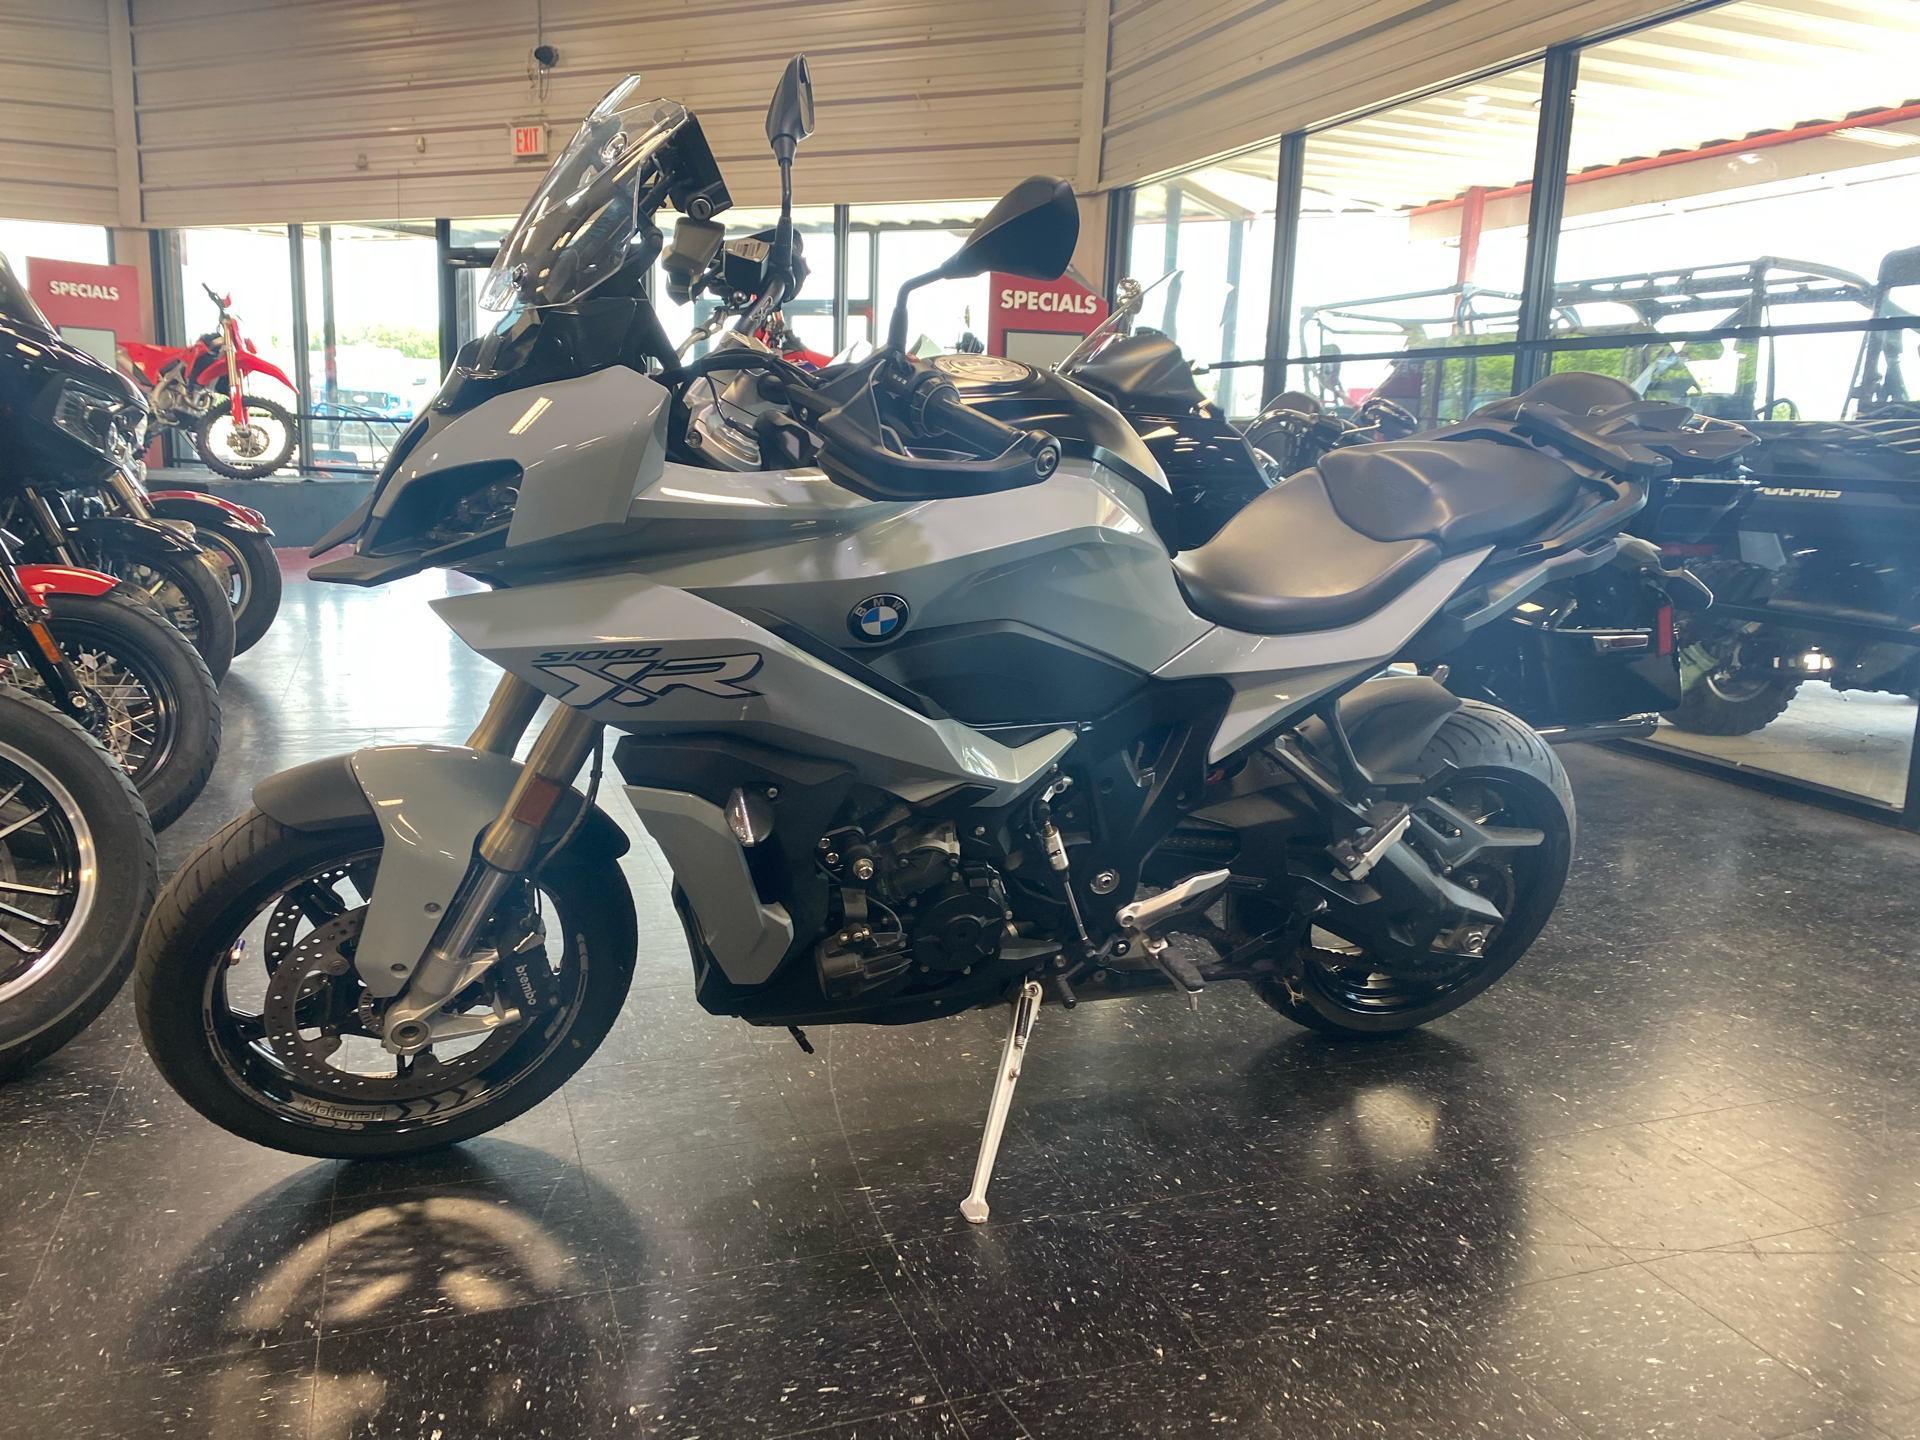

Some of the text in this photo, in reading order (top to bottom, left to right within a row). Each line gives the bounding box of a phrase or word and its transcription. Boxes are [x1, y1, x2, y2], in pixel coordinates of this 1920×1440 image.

[516, 128, 539, 153] EXIT
[49, 280, 119, 301] SPECIALS
[1000, 289, 1097, 314] SPECIALS
[854, 597, 905, 618] BMW
[531, 647, 663, 663] S1000
[531, 652, 767, 710] XR
[515, 964, 537, 1006] brembo
[302, 1101, 387, 1121] Motorrad
